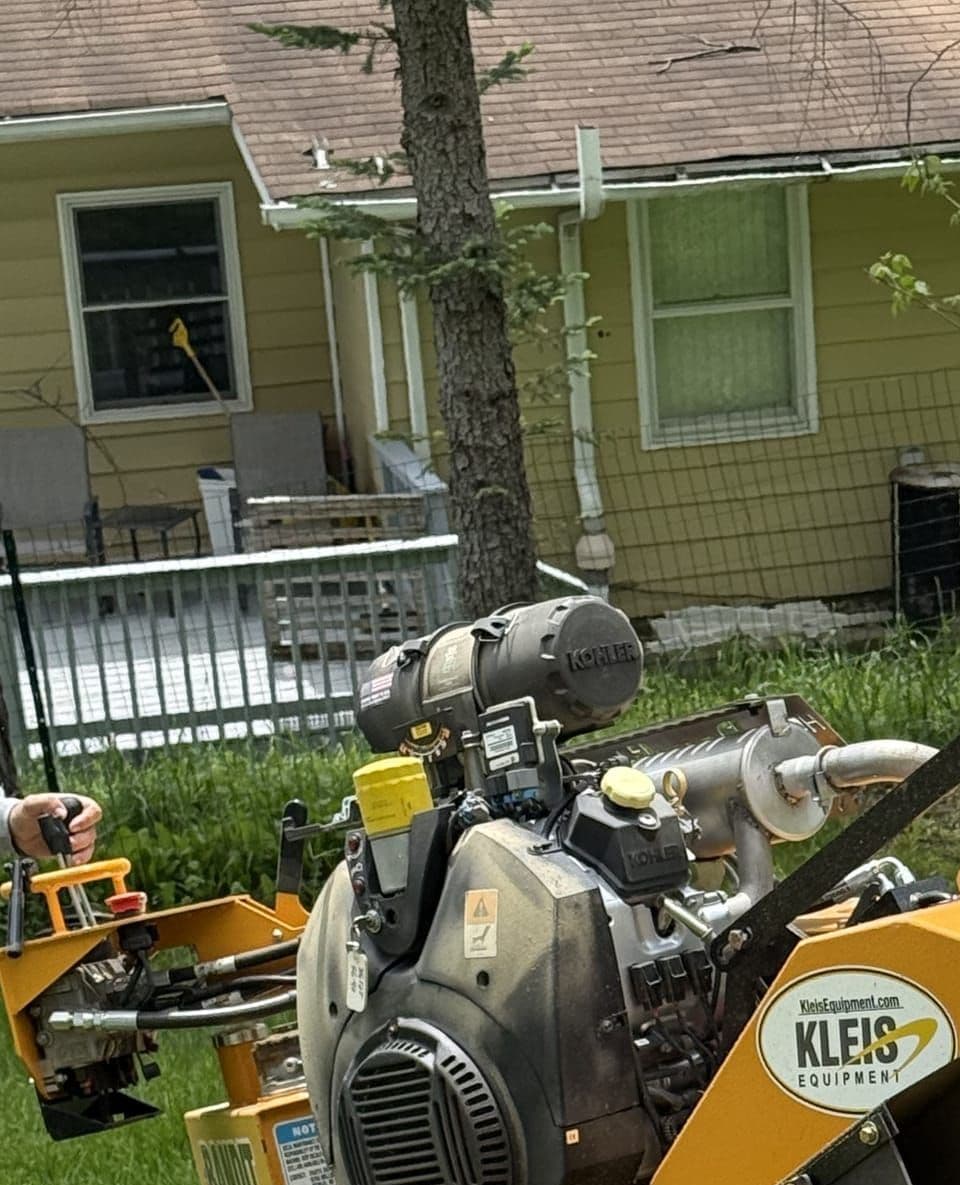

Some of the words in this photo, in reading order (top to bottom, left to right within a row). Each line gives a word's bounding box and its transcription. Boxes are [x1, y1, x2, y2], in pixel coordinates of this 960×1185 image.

[566, 642, 636, 672] KOHLER
[800, 995, 900, 1014] KleisEquipment.com
[795, 1015, 899, 1068] KLEIS
[798, 1069, 901, 1088] EQUIPMENT
[292, 1122, 316, 1137] NOT
